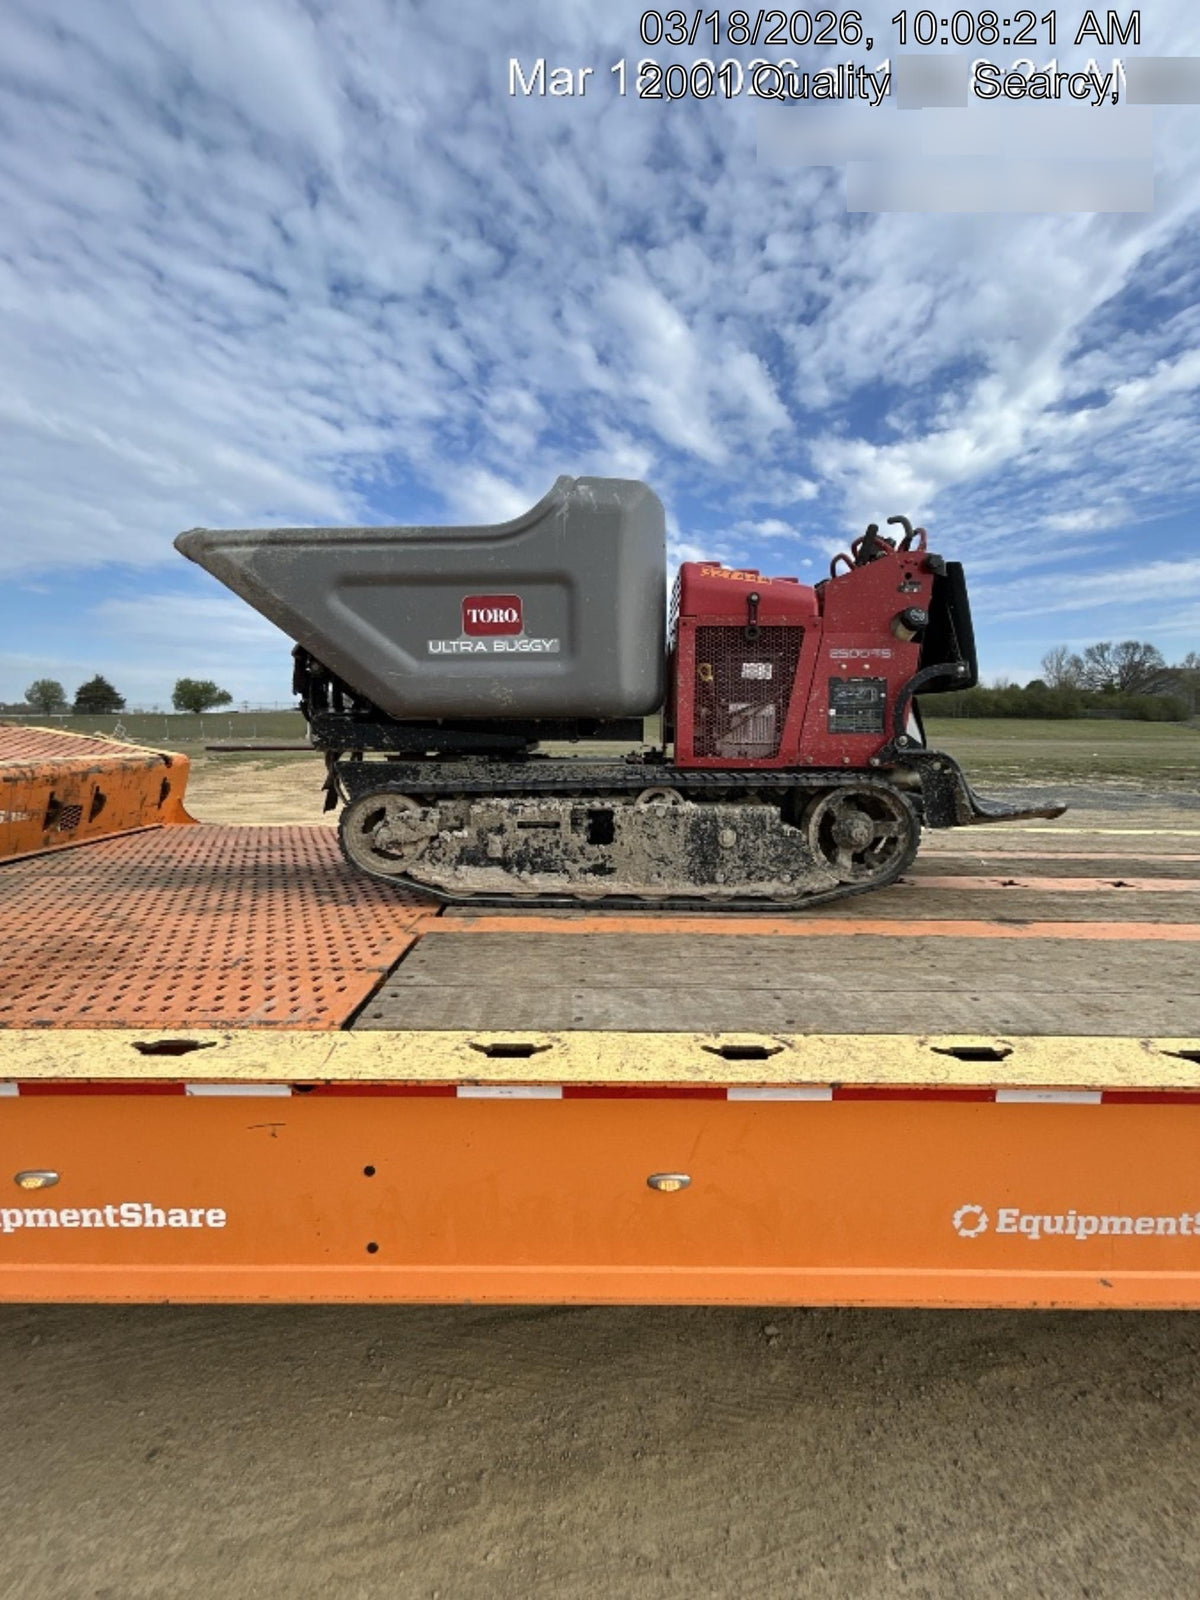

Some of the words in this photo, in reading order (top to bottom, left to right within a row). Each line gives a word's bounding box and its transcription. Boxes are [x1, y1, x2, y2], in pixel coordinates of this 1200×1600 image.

[467, 607, 518, 624] TORO
[429, 640, 488, 653] ULTRA
[493, 639, 553, 652] BUGGY
[0, 1203, 227, 1233] pmentShare
